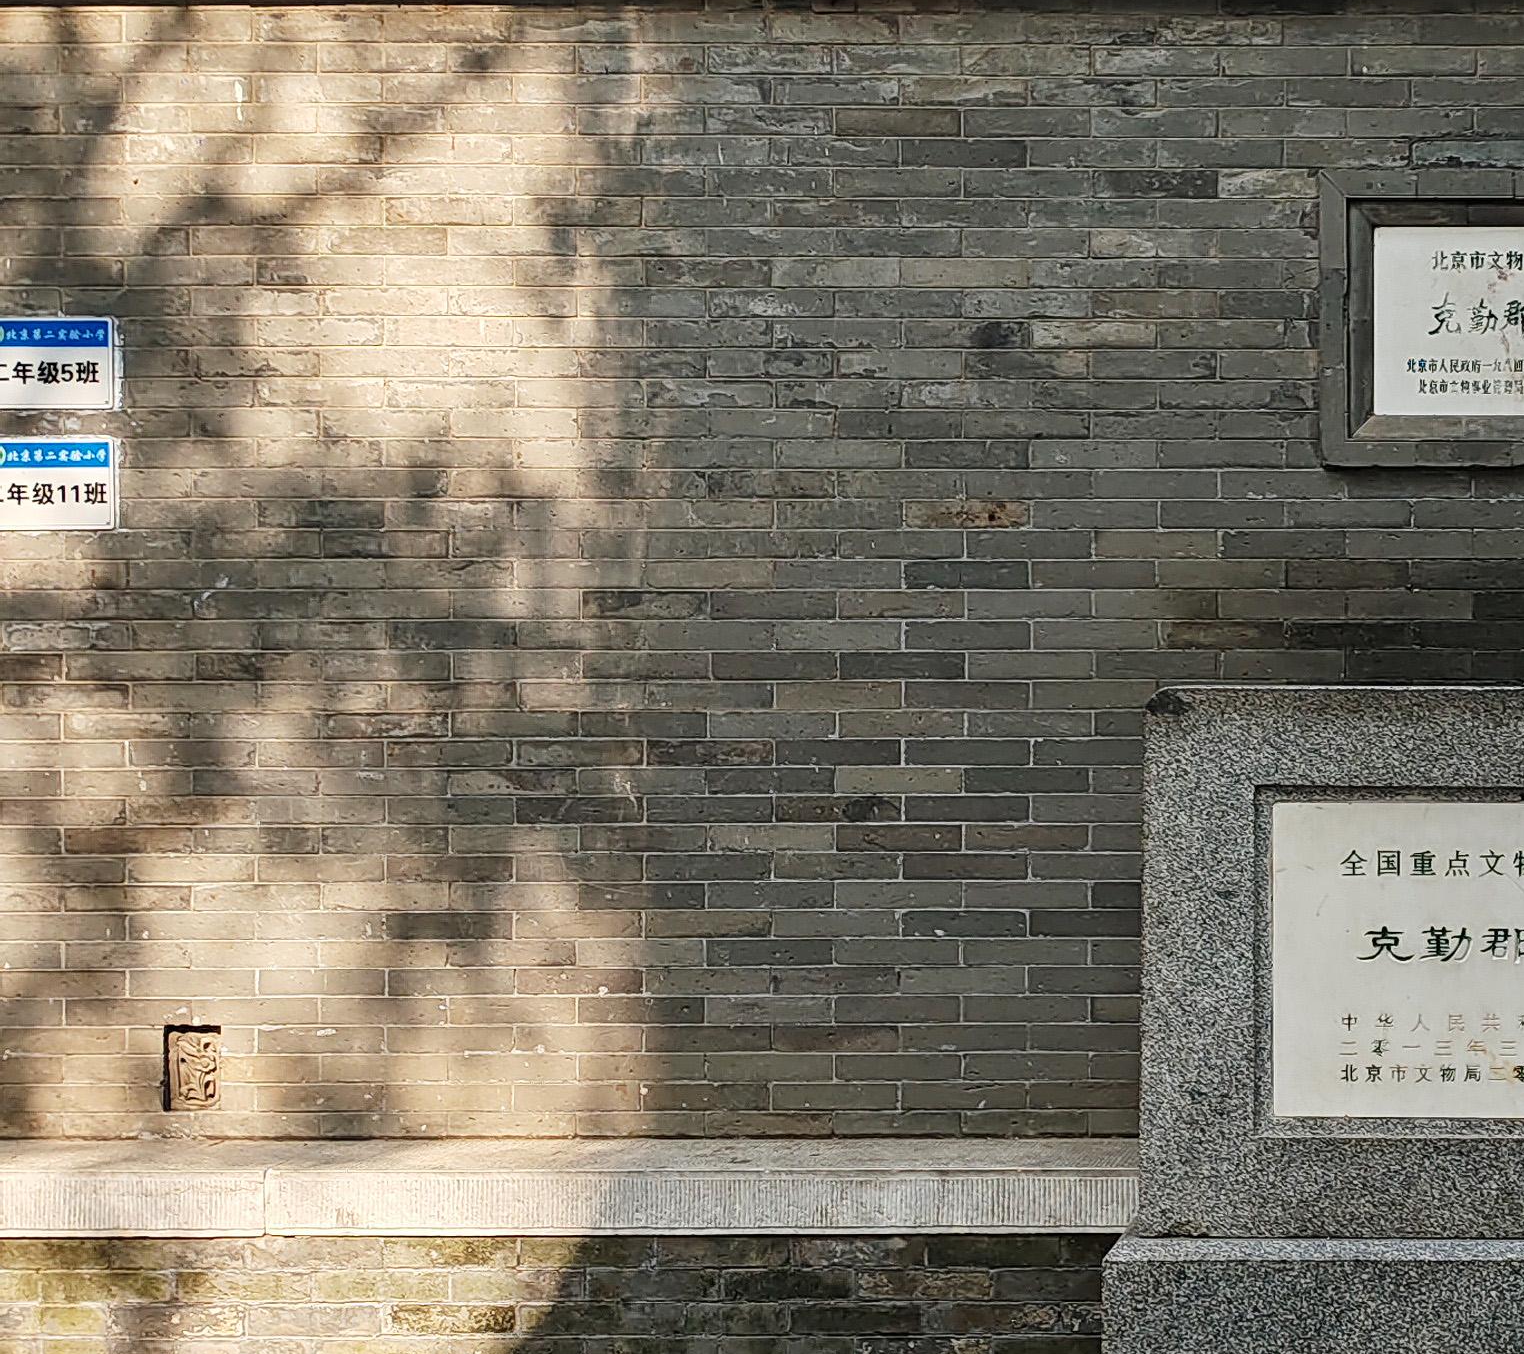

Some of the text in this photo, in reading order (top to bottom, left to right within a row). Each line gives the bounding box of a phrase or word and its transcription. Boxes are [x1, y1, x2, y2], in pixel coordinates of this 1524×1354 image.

[6, 327, 105, 341] 北京第二实验小学
[7, 448, 107, 463] 北京第二实验小学
[0, 481, 108, 505] 年级11班
